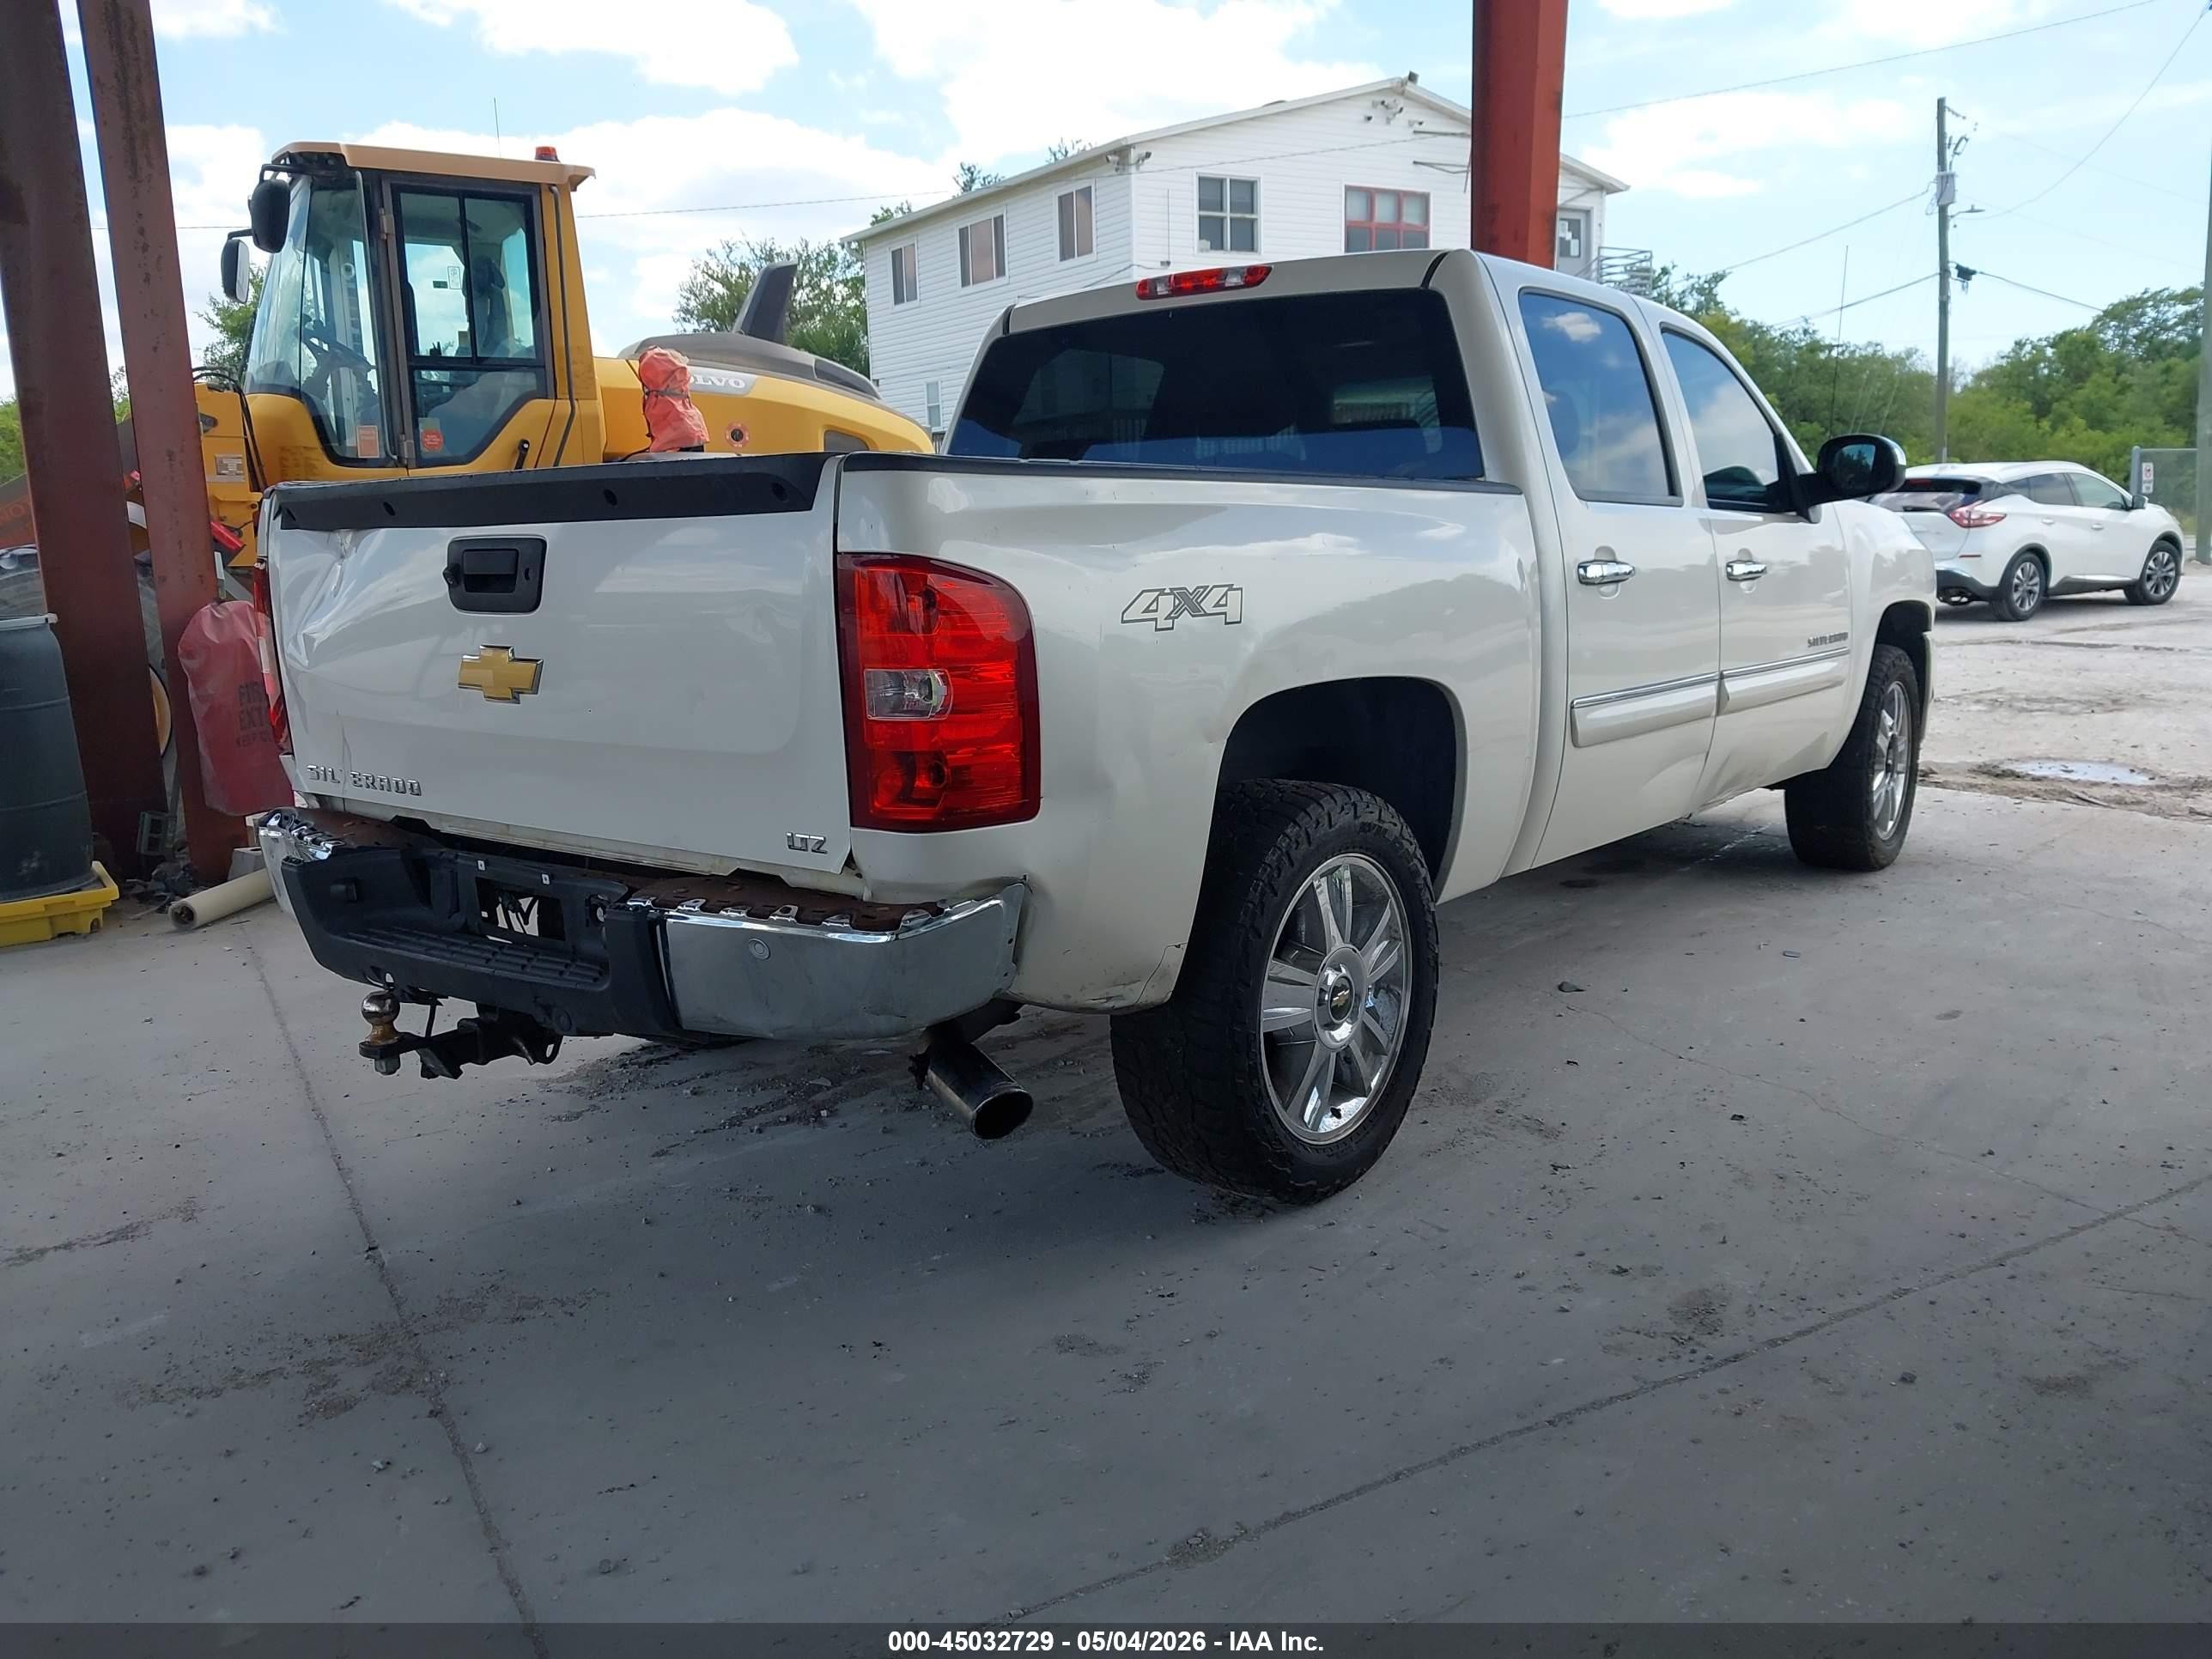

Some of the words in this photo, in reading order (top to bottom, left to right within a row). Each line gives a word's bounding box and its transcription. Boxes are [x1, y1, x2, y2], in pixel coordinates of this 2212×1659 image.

[690, 374, 746, 389] LVO
[307, 764, 422, 797] SILERADO
[787, 831, 828, 854] LTZ
